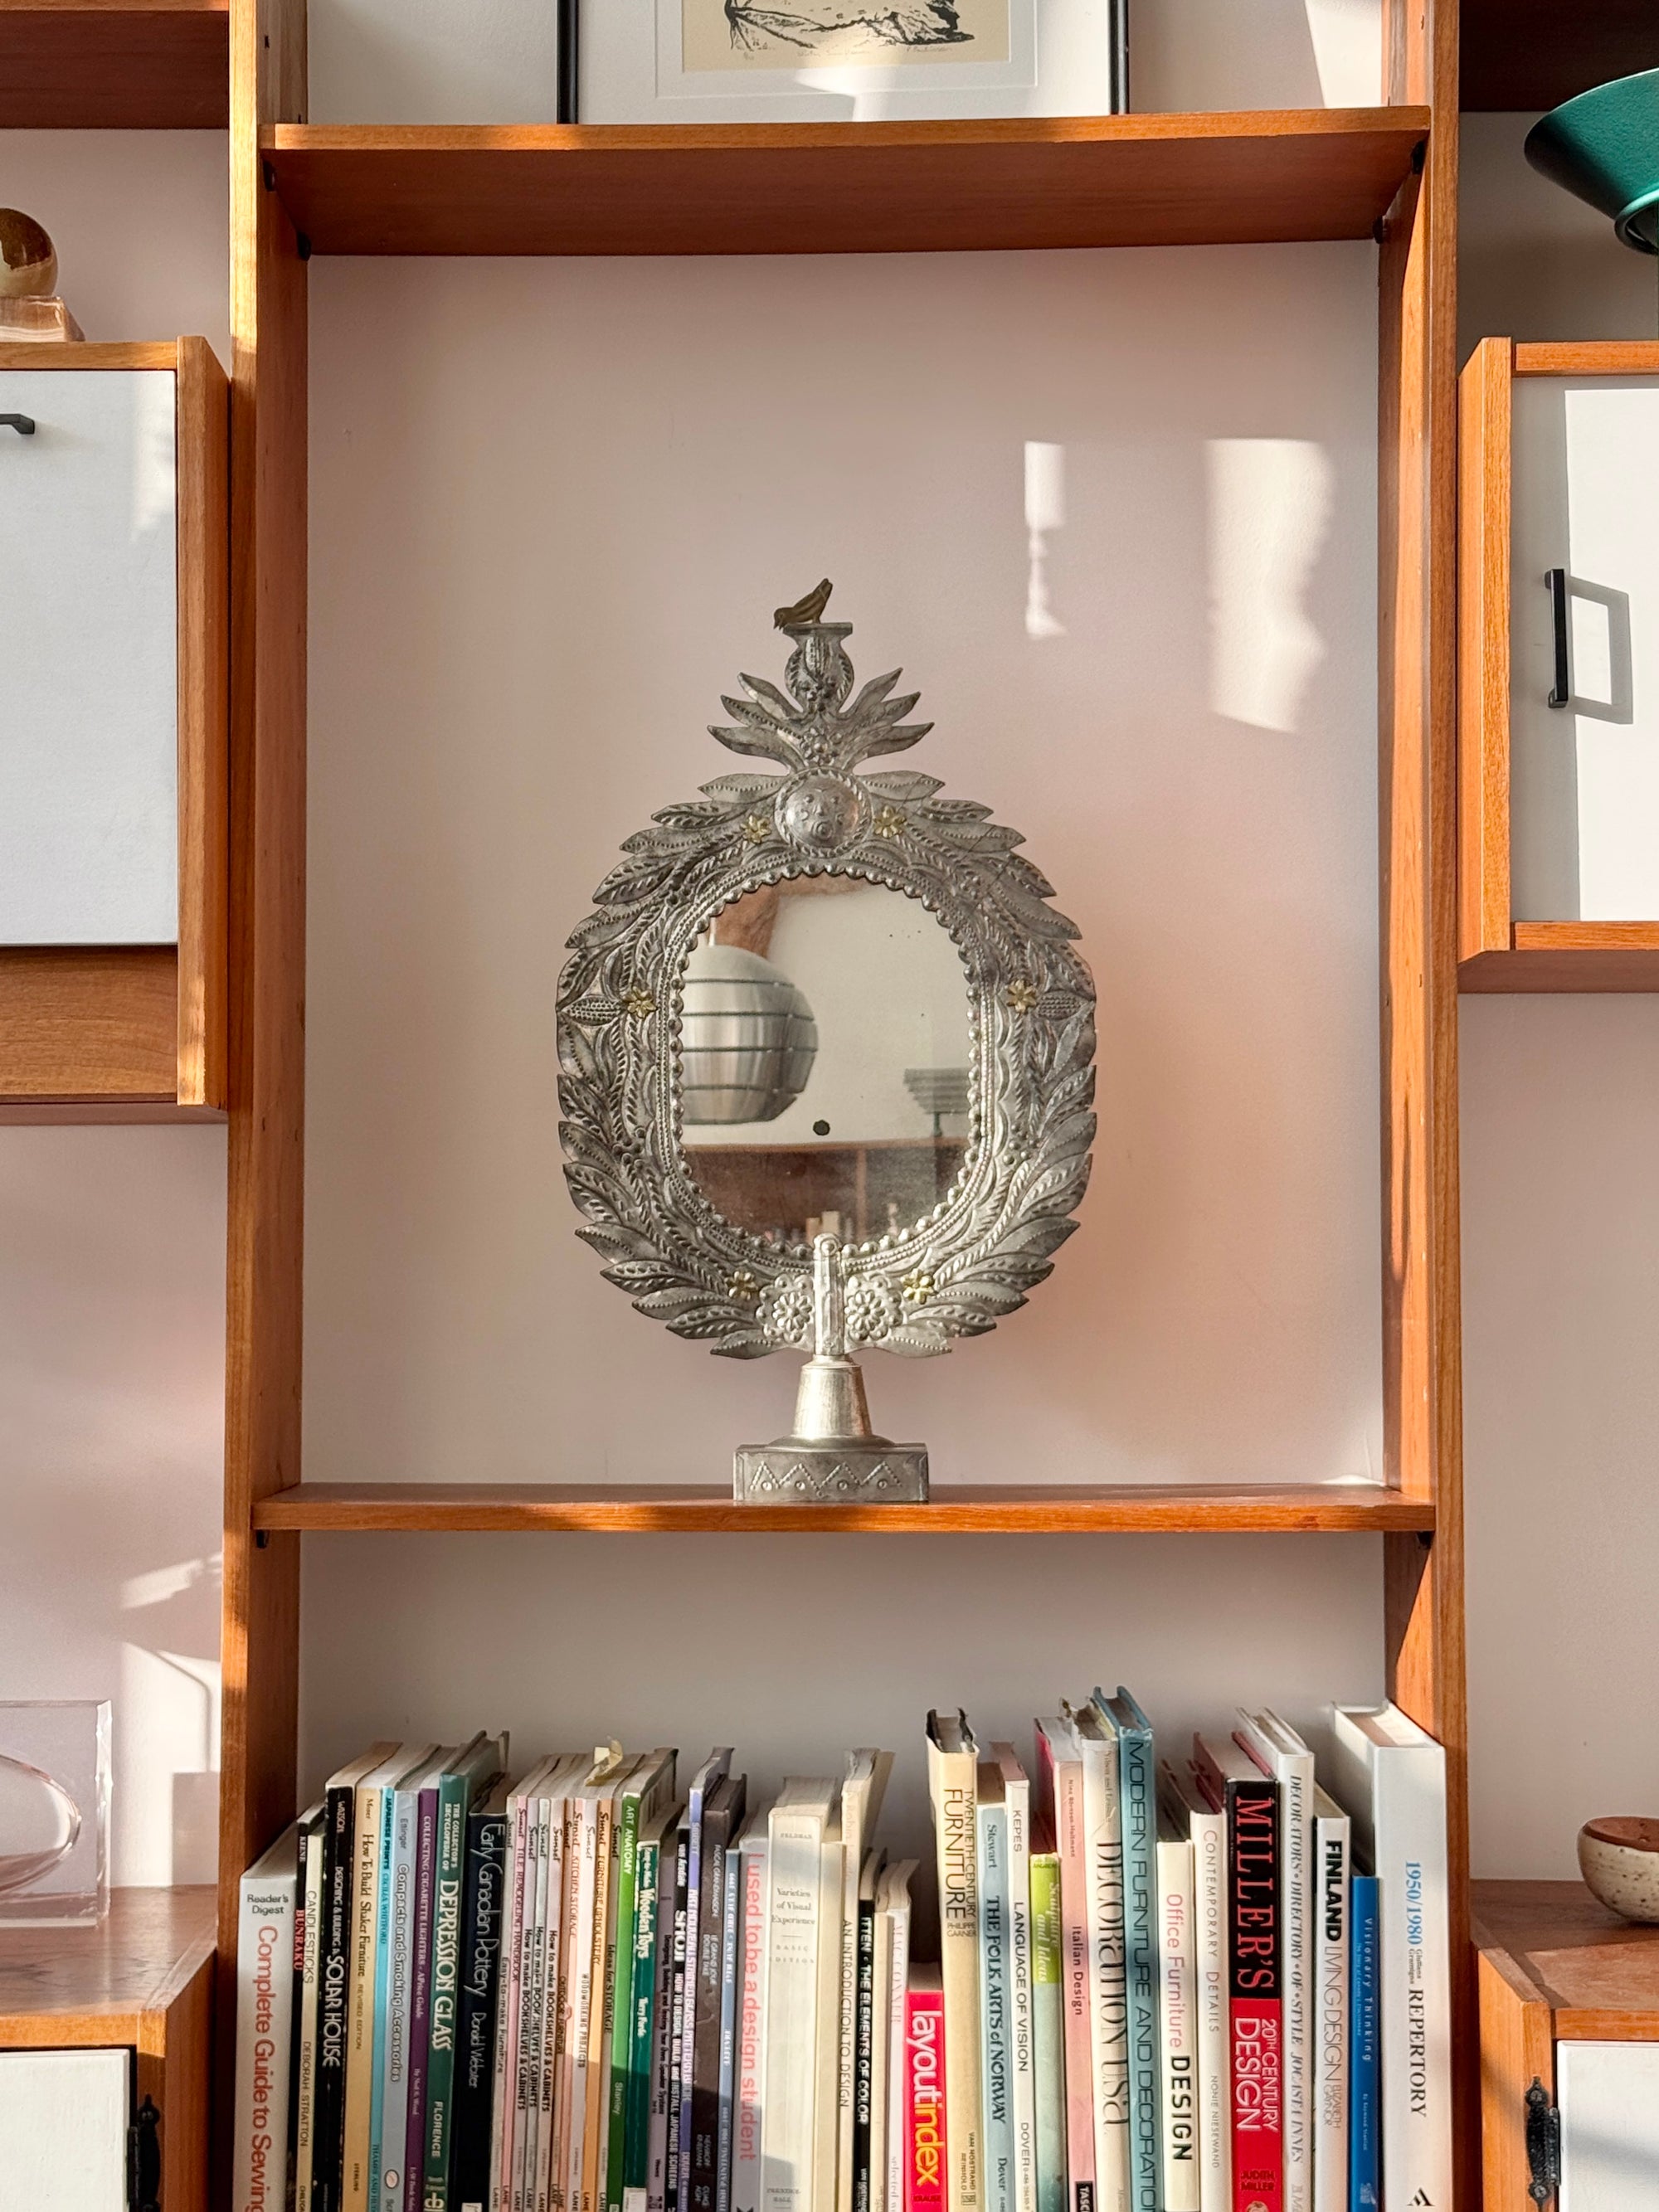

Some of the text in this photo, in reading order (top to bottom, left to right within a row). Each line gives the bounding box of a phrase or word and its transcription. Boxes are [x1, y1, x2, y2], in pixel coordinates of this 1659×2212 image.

[452, 1803, 460, 1819] THE
[598, 1811, 608, 1845] Sunset
[1128, 1742, 1146, 1851] MODERN
[362, 1834, 374, 1857] How
[382, 1796, 392, 1869] JAPANESE PRINTS
[418, 1816, 431, 1874] COLLECTING
[443, 1803, 452, 1860] ENCYCLOPEDIA
[552, 1827, 562, 1861] Sunset
[623, 1806, 635, 1876] ART ANATOMY
[944, 1788, 966, 1918] FURNITURE
[964, 1788, 976, 1918] TWENTIETH-CENTURY
[986, 1824, 997, 1869] Stewart
[1013, 1810, 1022, 1852] KEPES
[247, 1894, 289, 1903] Reader's
[359, 1873, 372, 1897] Build
[362, 1858, 373, 1873] To
[746, 1864, 763, 1913] used
[776, 1888, 811, 1898] Varieties
[1236, 1796, 1274, 1988] MILLER'S
[252, 1905, 285, 1916] Digest
[358, 1901, 371, 1934] Shaker
[464, 1823, 505, 1999] Early Canadian Pottery
[635, 1889, 655, 1958] Wooden Toys
[674, 1909, 686, 1962] SHOJI
[745, 1920, 762, 1944] to
[771, 1915, 815, 1925] Experience
[786, 1902, 812, 1911] Visual
[1132, 1861, 1151, 1997] FURNITURE
[1204, 1830, 1219, 2032] CONTEMPORARY DETAILS
[1405, 1861, 1423, 1945] 1950/1980
[293, 1909, 305, 1971] BUNRAKU
[302, 1890, 316, 1983] CANDLESTICKS
[322, 1866, 345, 2068] DESIGNING SOLAR HOUSE
[358, 1934, 370, 1977] Furniture
[432, 1880, 459, 2051] DEPRESSION GLASS
[745, 1947, 762, 1974] be
[1037, 1945, 1052, 1982] Ideas
[1097, 1842, 1127, 2044] DECORATION
[1291, 1775, 1303, 2162] DECORATORS' DIRECTORY OF STYLE INNES
[1324, 1840, 1342, 2082] FINLAND DESIGN
[256, 1925, 278, 2034] Complete
[391, 1864, 409, 2083] Compacts and Smoking Accessories
[685, 1956, 697, 1997] STAINED
[745, 1980, 757, 1992] a
[1014, 1902, 1029, 2072] LANGUAGE OF VISION
[1072, 1926, 1085, 2015] Italian Design
[1363, 1918, 1373, 2061] Visionary Thinking
[520, 1988, 530, 2059] BOOKSHELVES
[542, 1930, 557, 2112] How make BOOKSHELVES CABINETS
[605, 1983, 614, 2032] STORAGE
[742, 1991, 761, 2070] design
[839, 1919, 853, 2107] AN INTRODUCTION TO DESIGN
[858, 1917, 872, 2125] ITTEN THE ELEMENTS OF COLOR
[985, 1896, 1006, 2124] THE FOLK ARTS of NORWAY
[1135, 2006, 1152, 2062] AND
[1166, 1894, 1193, 2161] Office Furniture DESIGN
[254, 2039, 275, 2103] Guide
[469, 2012, 486, 2088] Donald Webster
[1235, 2017, 1262, 2131] DESIGN
[1262, 2019, 1279, 2132] 20TH CENTURY
[1408, 1988, 1427, 2117] REPERTORY
[252, 2106, 271, 2129] to
[300, 2041, 311, 2146] DEBORAH STRATTON
[518, 2067, 527, 2110] CABINETS
[529, 2064, 538, 2107] CABINETS
[612, 2082, 623, 2116] Stanley
[668, 2005, 683, 2190] DESIGN, INSTALL JAPANESE SCREENS
[1324, 2085, 1332, 2126] GAYNOR
[1332, 2085, 1341, 2128] ELIZABETH
[431, 2101, 443, 2158] FLORENCE
[740, 2077, 758, 2161] student
[1020, 2122, 1029, 2166] DOVER
[1210, 2075, 1220, 2168] NONIE NIESEWAND
[997, 2158, 1008, 2191] Dover
